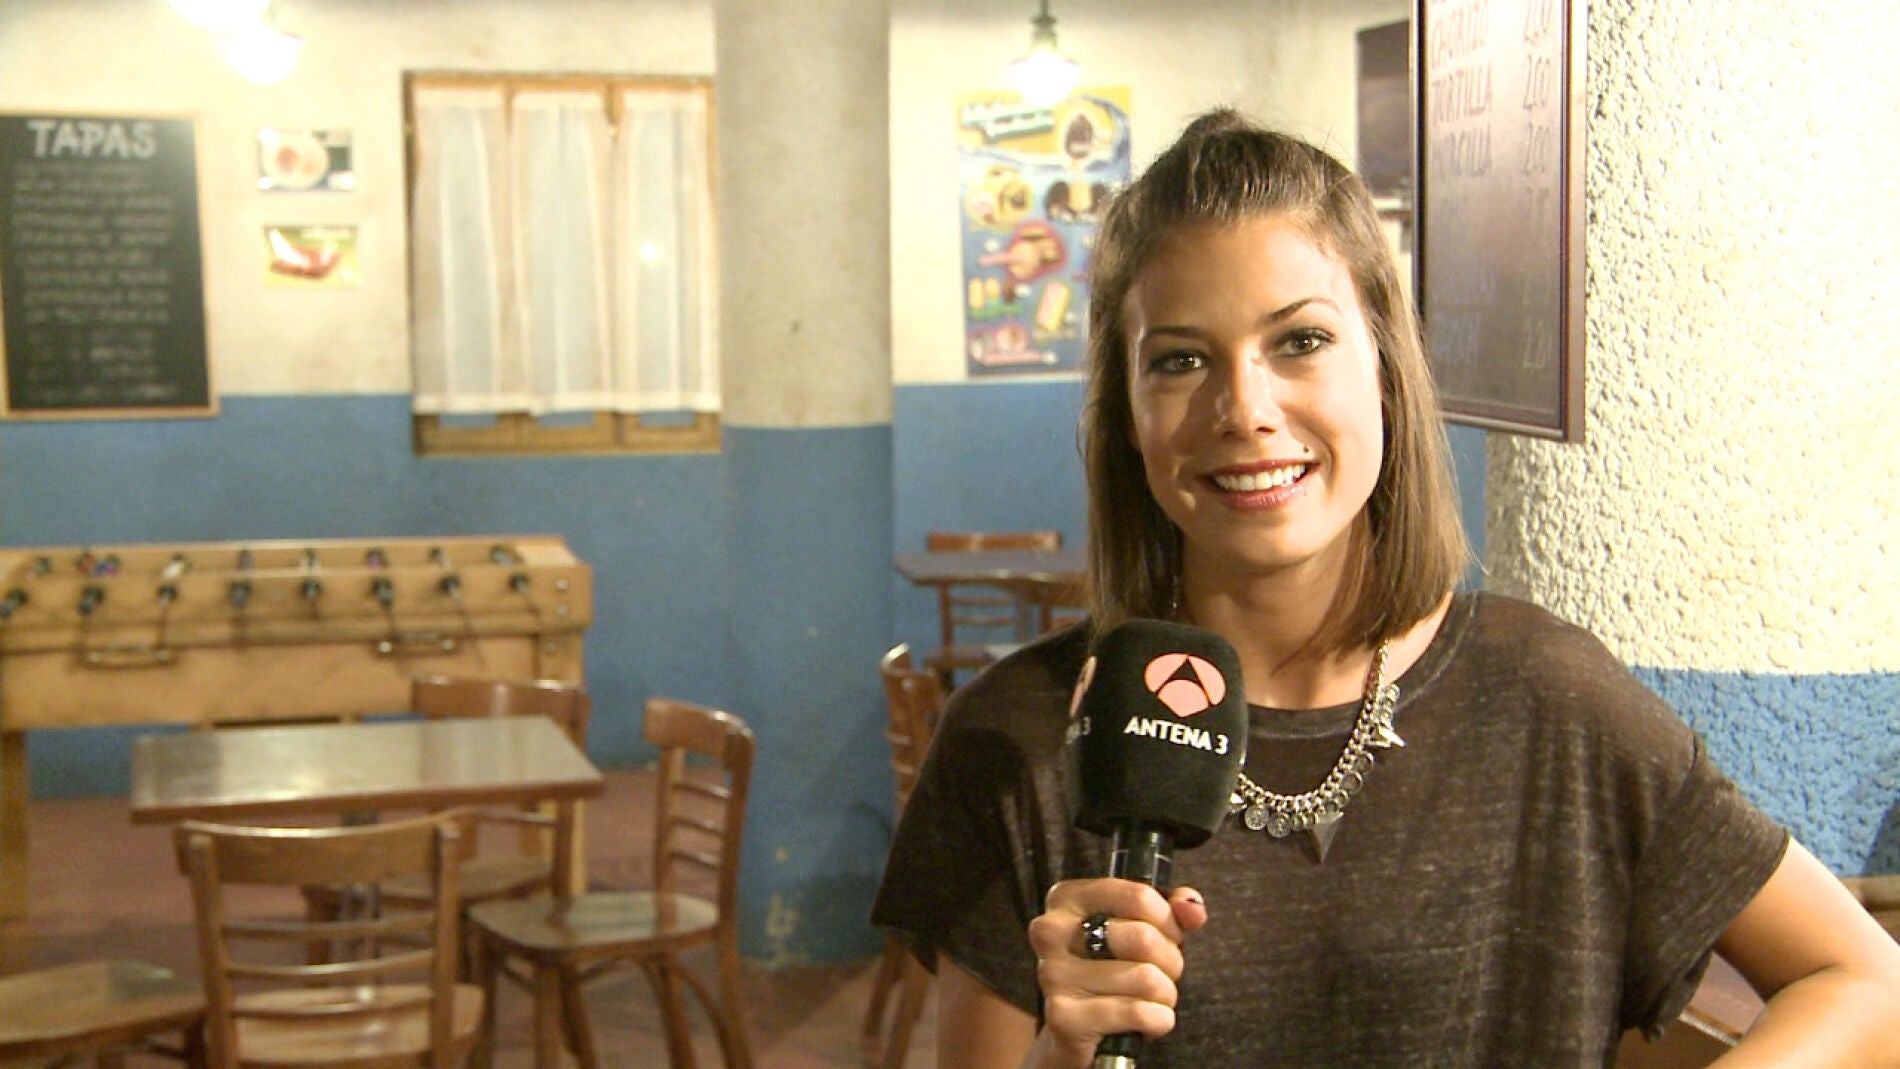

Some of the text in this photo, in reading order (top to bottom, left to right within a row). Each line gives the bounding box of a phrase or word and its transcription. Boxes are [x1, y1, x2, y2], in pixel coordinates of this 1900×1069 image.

[1431, 63, 1493, 127] TORTILLA
[27, 119, 157, 159] TAPAS
[1123, 716, 1229, 755] ANTENA 3
